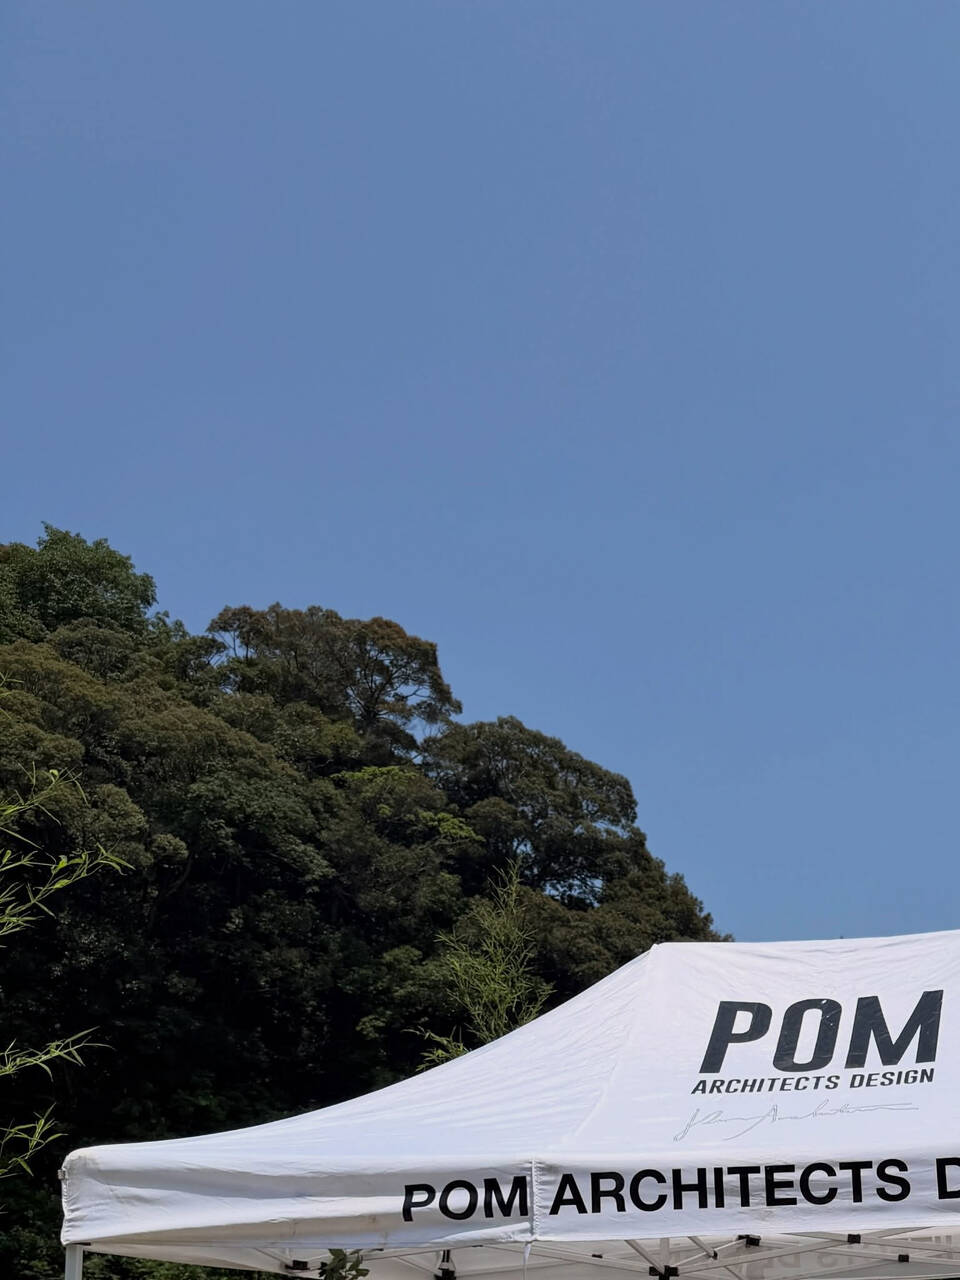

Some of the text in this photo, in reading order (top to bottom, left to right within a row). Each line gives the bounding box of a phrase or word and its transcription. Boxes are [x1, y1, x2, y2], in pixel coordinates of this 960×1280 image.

[698, 989, 944, 1074] POM
[690, 1067, 935, 1095] ARCHITECTS DESIGN
[402, 1175, 529, 1222] POM
[548, 1158, 911, 1216] ARCHITECTS
